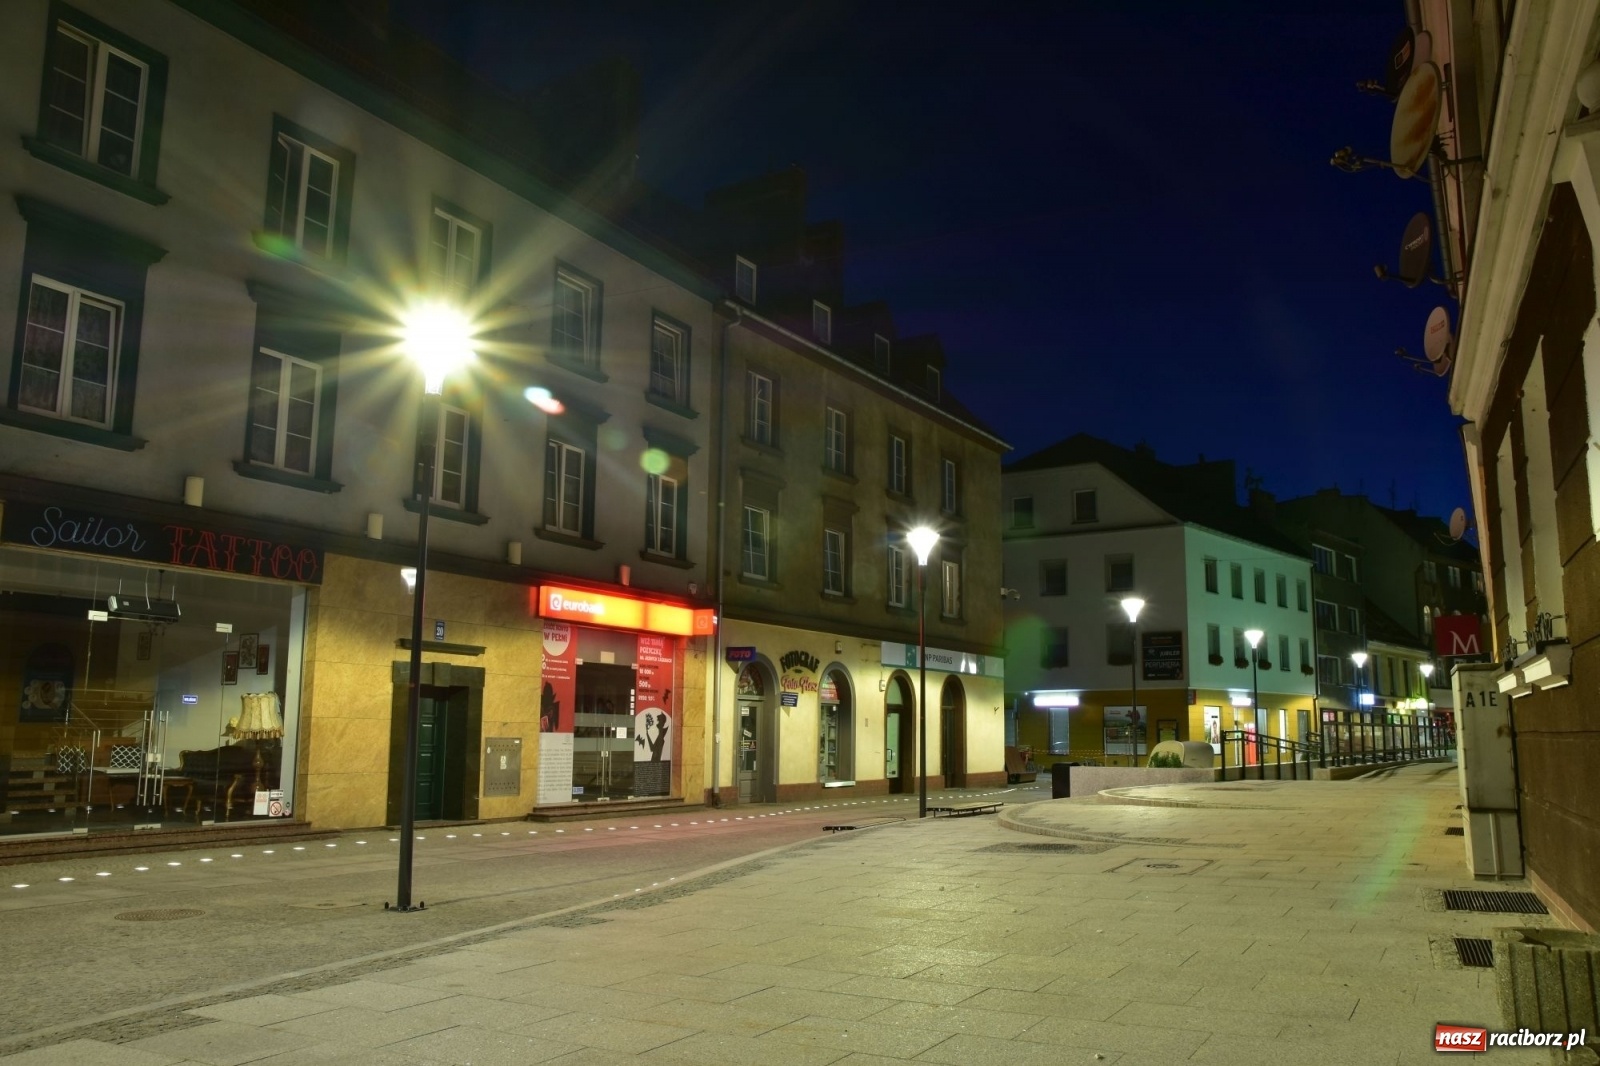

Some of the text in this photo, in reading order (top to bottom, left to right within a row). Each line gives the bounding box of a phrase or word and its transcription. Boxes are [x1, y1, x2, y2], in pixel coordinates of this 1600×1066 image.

[30, 505, 319, 582] Sailor TATTOO
[563, 600, 603, 614] euroba
[1450, 630, 1480, 655] M
[730, 650, 752, 658] FOTO
[780, 650, 820, 673] FOTOGRAF
[932, 654, 953, 665] PARIBAS
